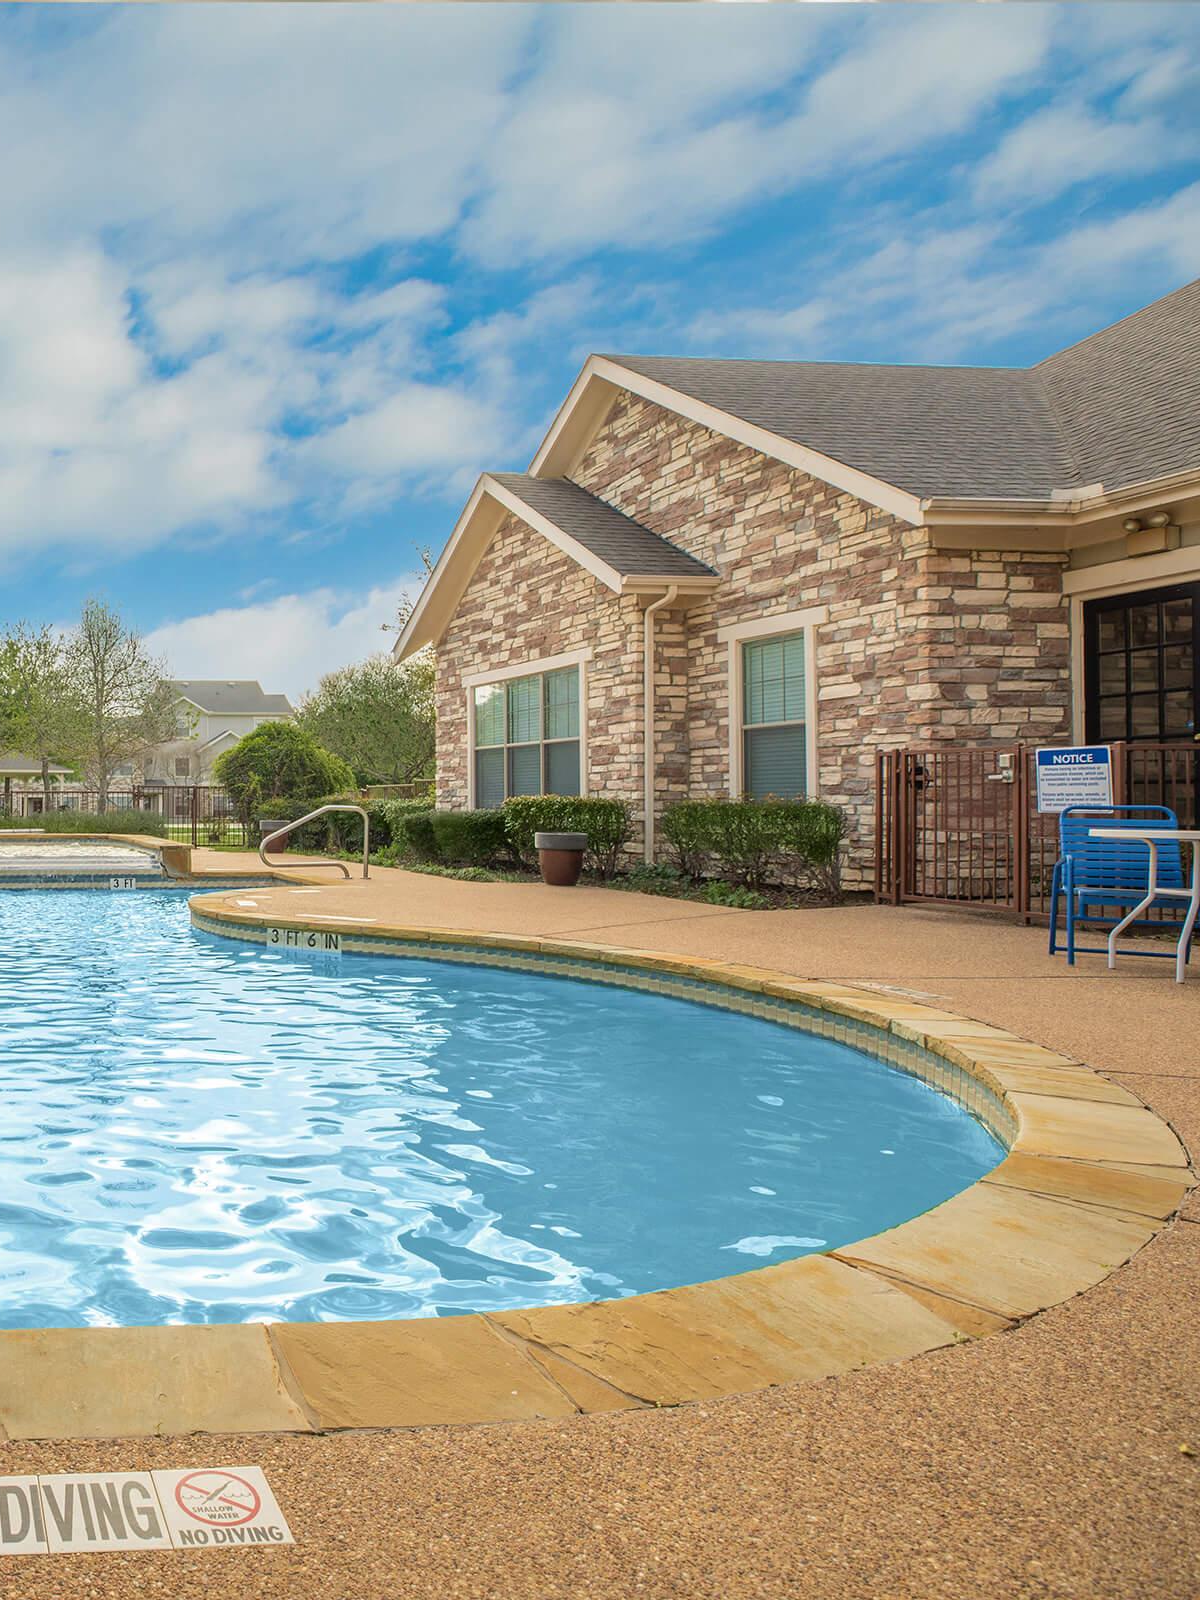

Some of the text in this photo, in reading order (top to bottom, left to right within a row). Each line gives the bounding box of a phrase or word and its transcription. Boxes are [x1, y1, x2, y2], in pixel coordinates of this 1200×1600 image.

[1052, 753, 1094, 764] NOTICE
[113, 879, 133, 888] 3 FT
[271, 929, 339, 949] 3 FT 6 IN
[192, 1505, 233, 1513] SHALLOW
[208, 1512, 240, 1520] WATER
[179, 1526, 284, 1545] NO DIVING
